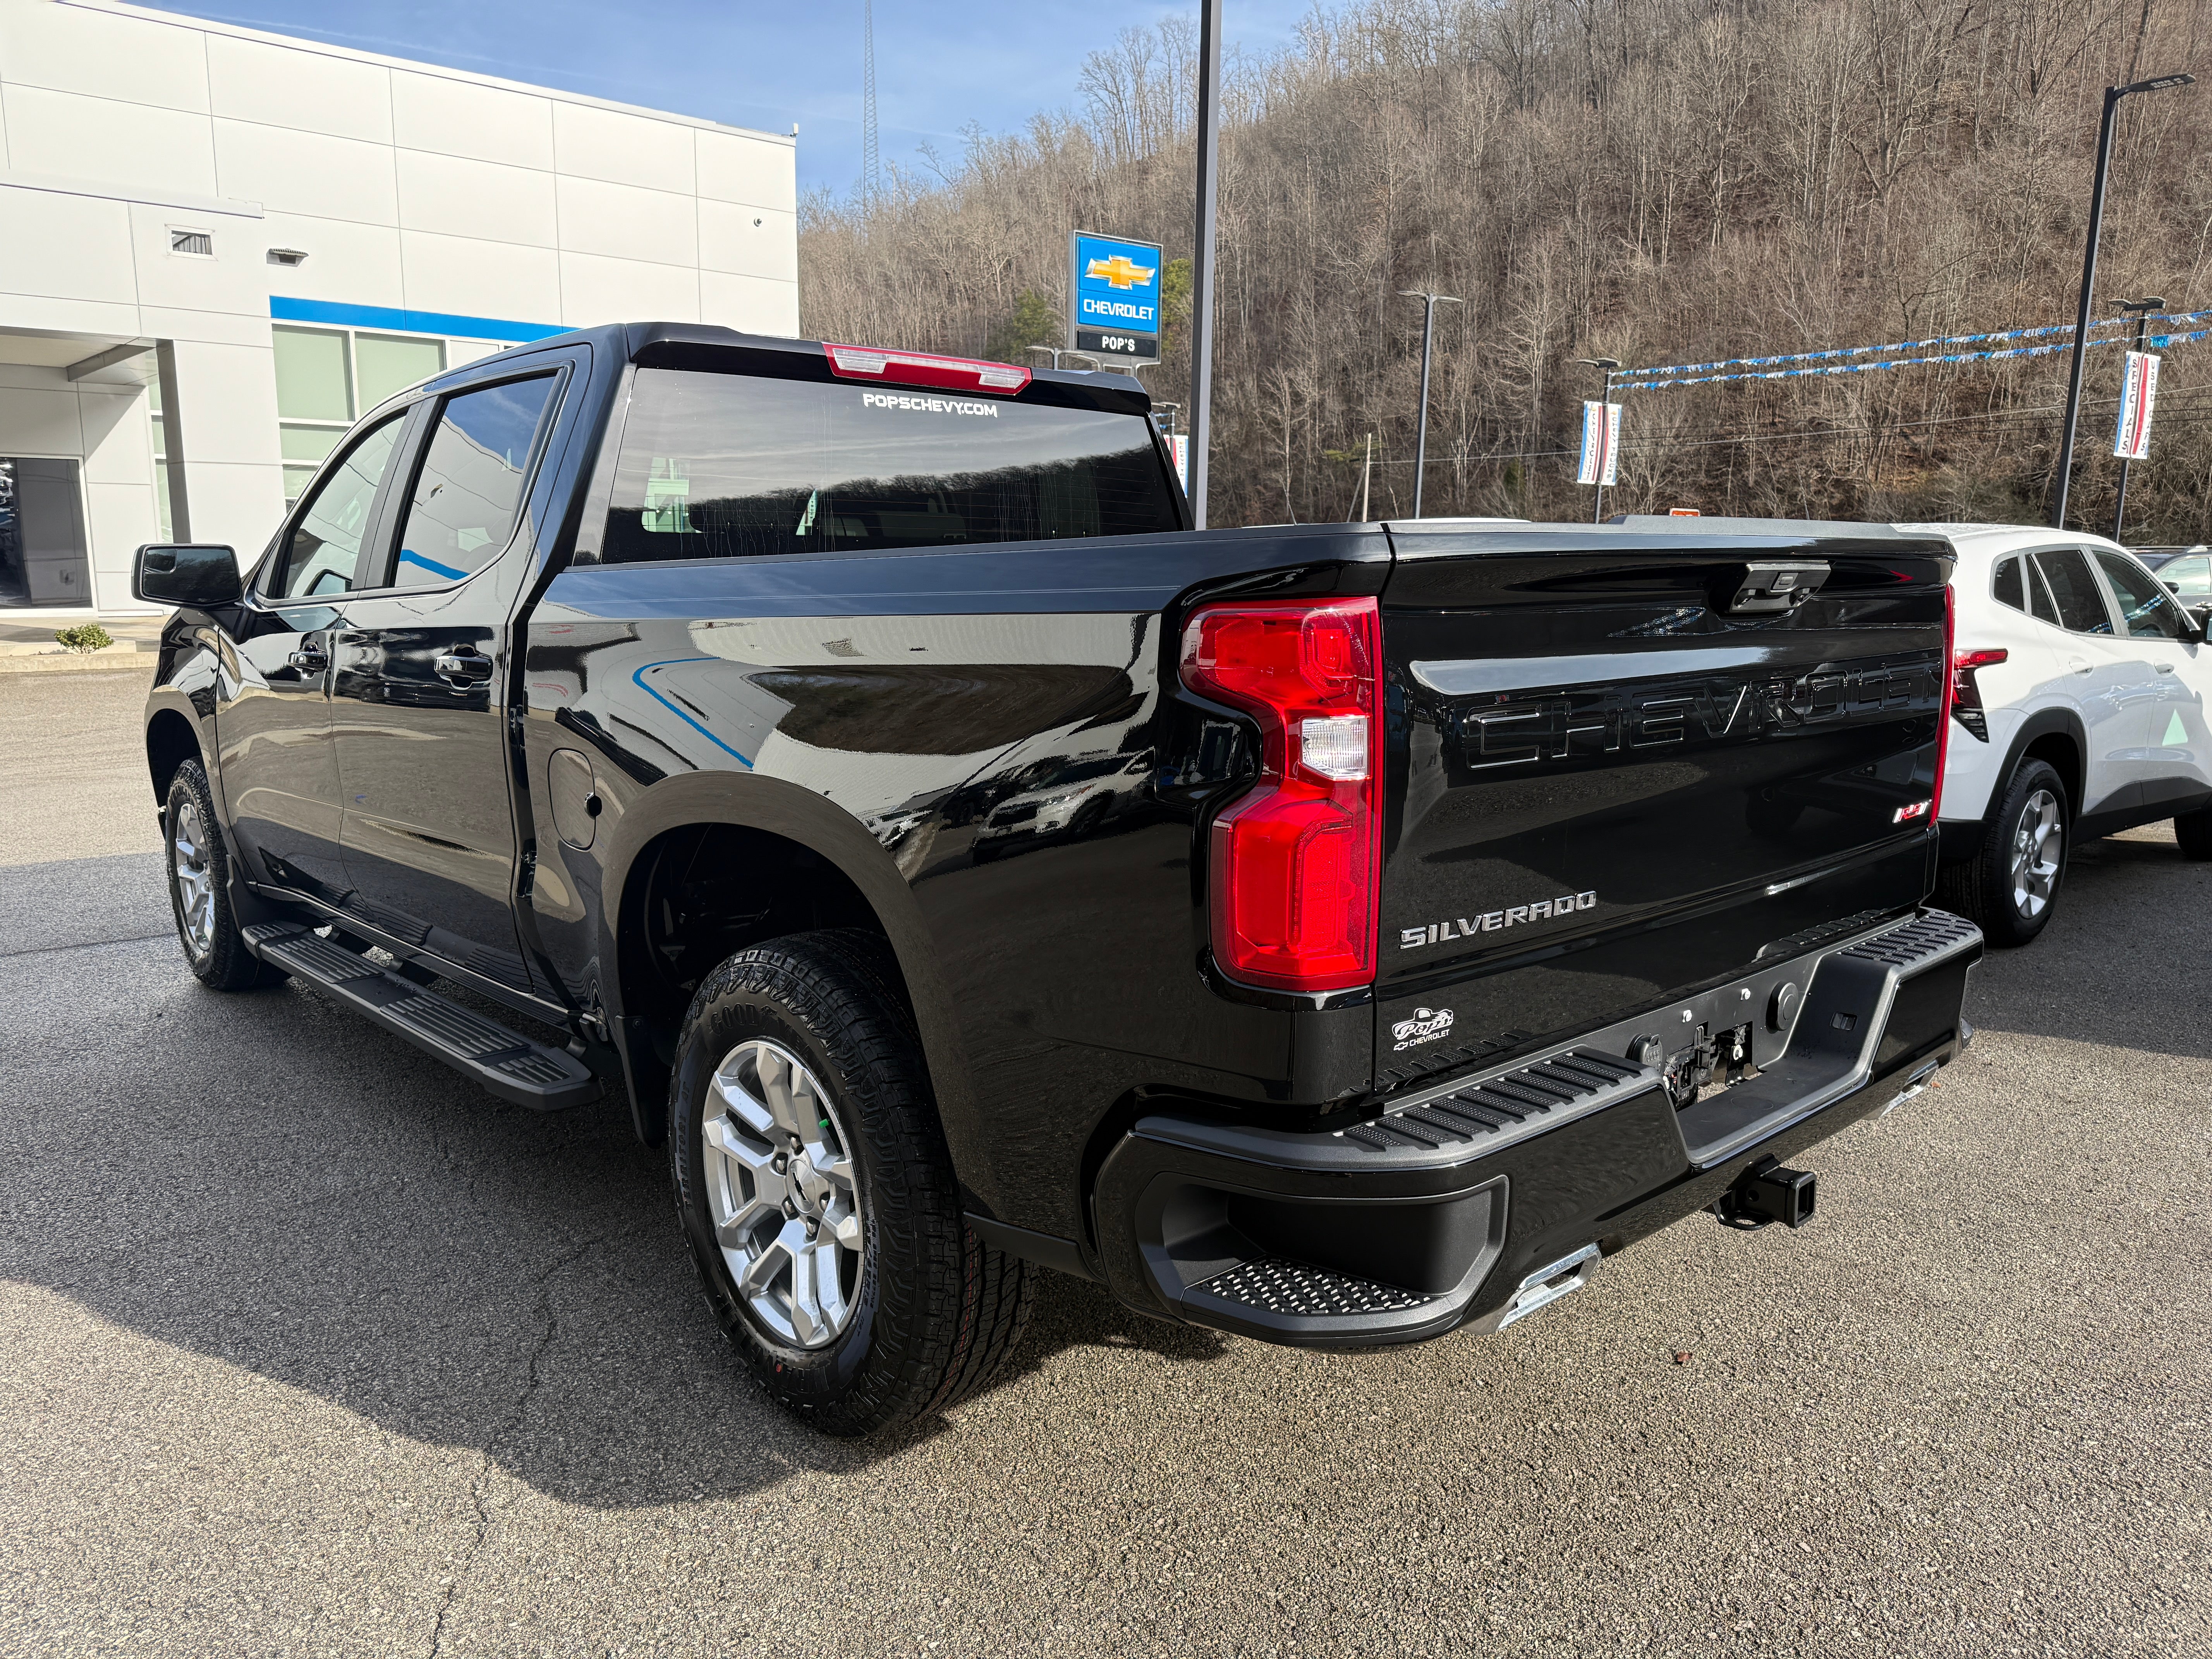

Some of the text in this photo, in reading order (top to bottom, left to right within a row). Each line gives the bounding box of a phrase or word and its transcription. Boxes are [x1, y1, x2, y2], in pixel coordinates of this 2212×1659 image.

[1083, 299, 1154, 320] CHEVROLET
[1102, 335, 1135, 352] POP'S
[862, 393, 998, 418] POPSCHEVY.COM
[2122, 359, 2137, 450] SPECIALS
[1466, 656, 1941, 770] CHEVROLET
[1398, 890, 1597, 950] SILVERADO
[1409, 1029, 1450, 1047] CHEVROLET
